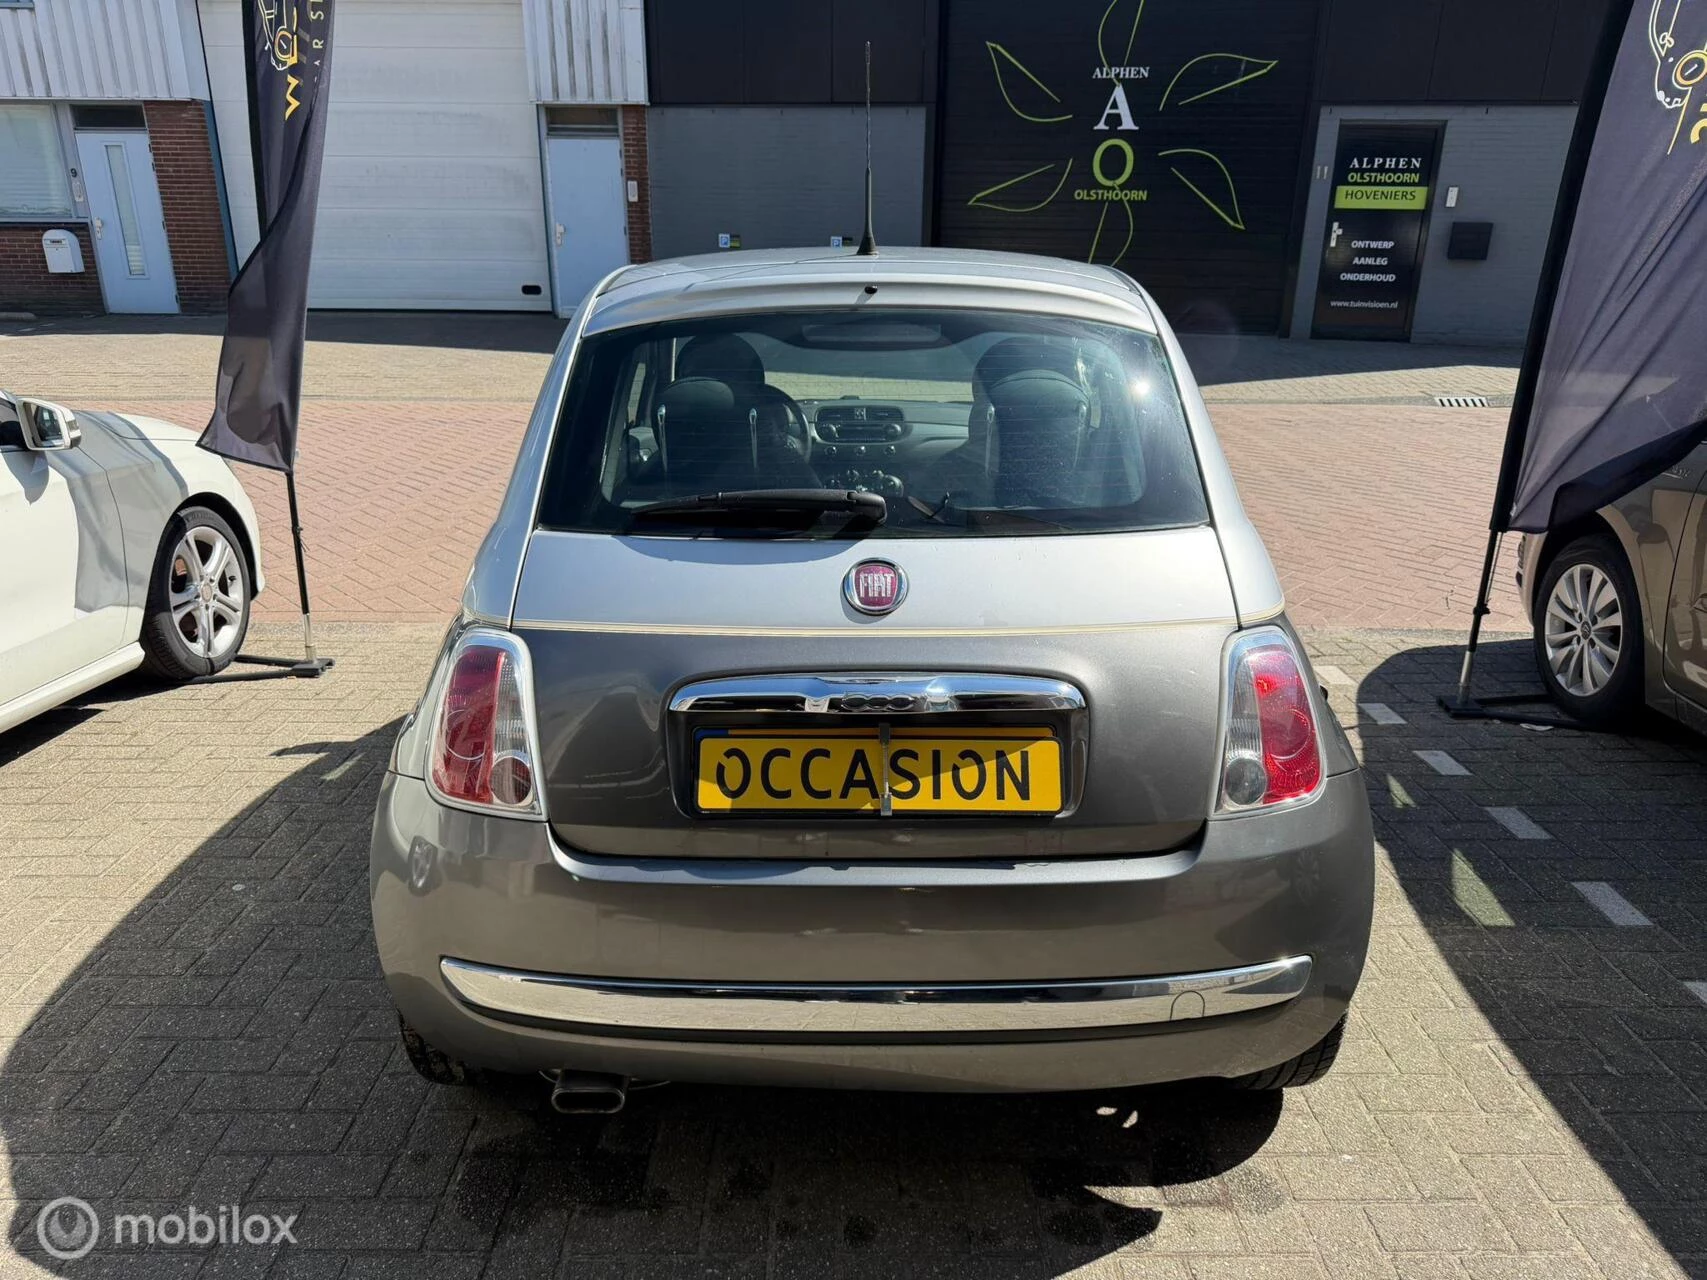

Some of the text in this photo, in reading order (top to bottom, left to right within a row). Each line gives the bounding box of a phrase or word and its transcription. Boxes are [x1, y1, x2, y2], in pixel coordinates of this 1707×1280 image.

[1092, 66, 1150, 79] ALPHEN
[1092, 82, 1140, 130] A
[1092, 138, 1135, 187] O
[1349, 157, 1422, 169] ALPHEN
[70, 167, 78, 178] 9
[1347, 172, 1420, 183] OLSTHOORN
[1074, 189, 1148, 201] OLSTHOORN
[1344, 189, 1417, 201] HOVENIERS
[1351, 240, 1395, 249] ONTWERP
[1352, 256, 1388, 265] AANLEG
[1340, 272, 1396, 282] ONDERHOUD
[859, 573, 895, 598] FIAT
[715, 747, 1031, 801] OCCASION
